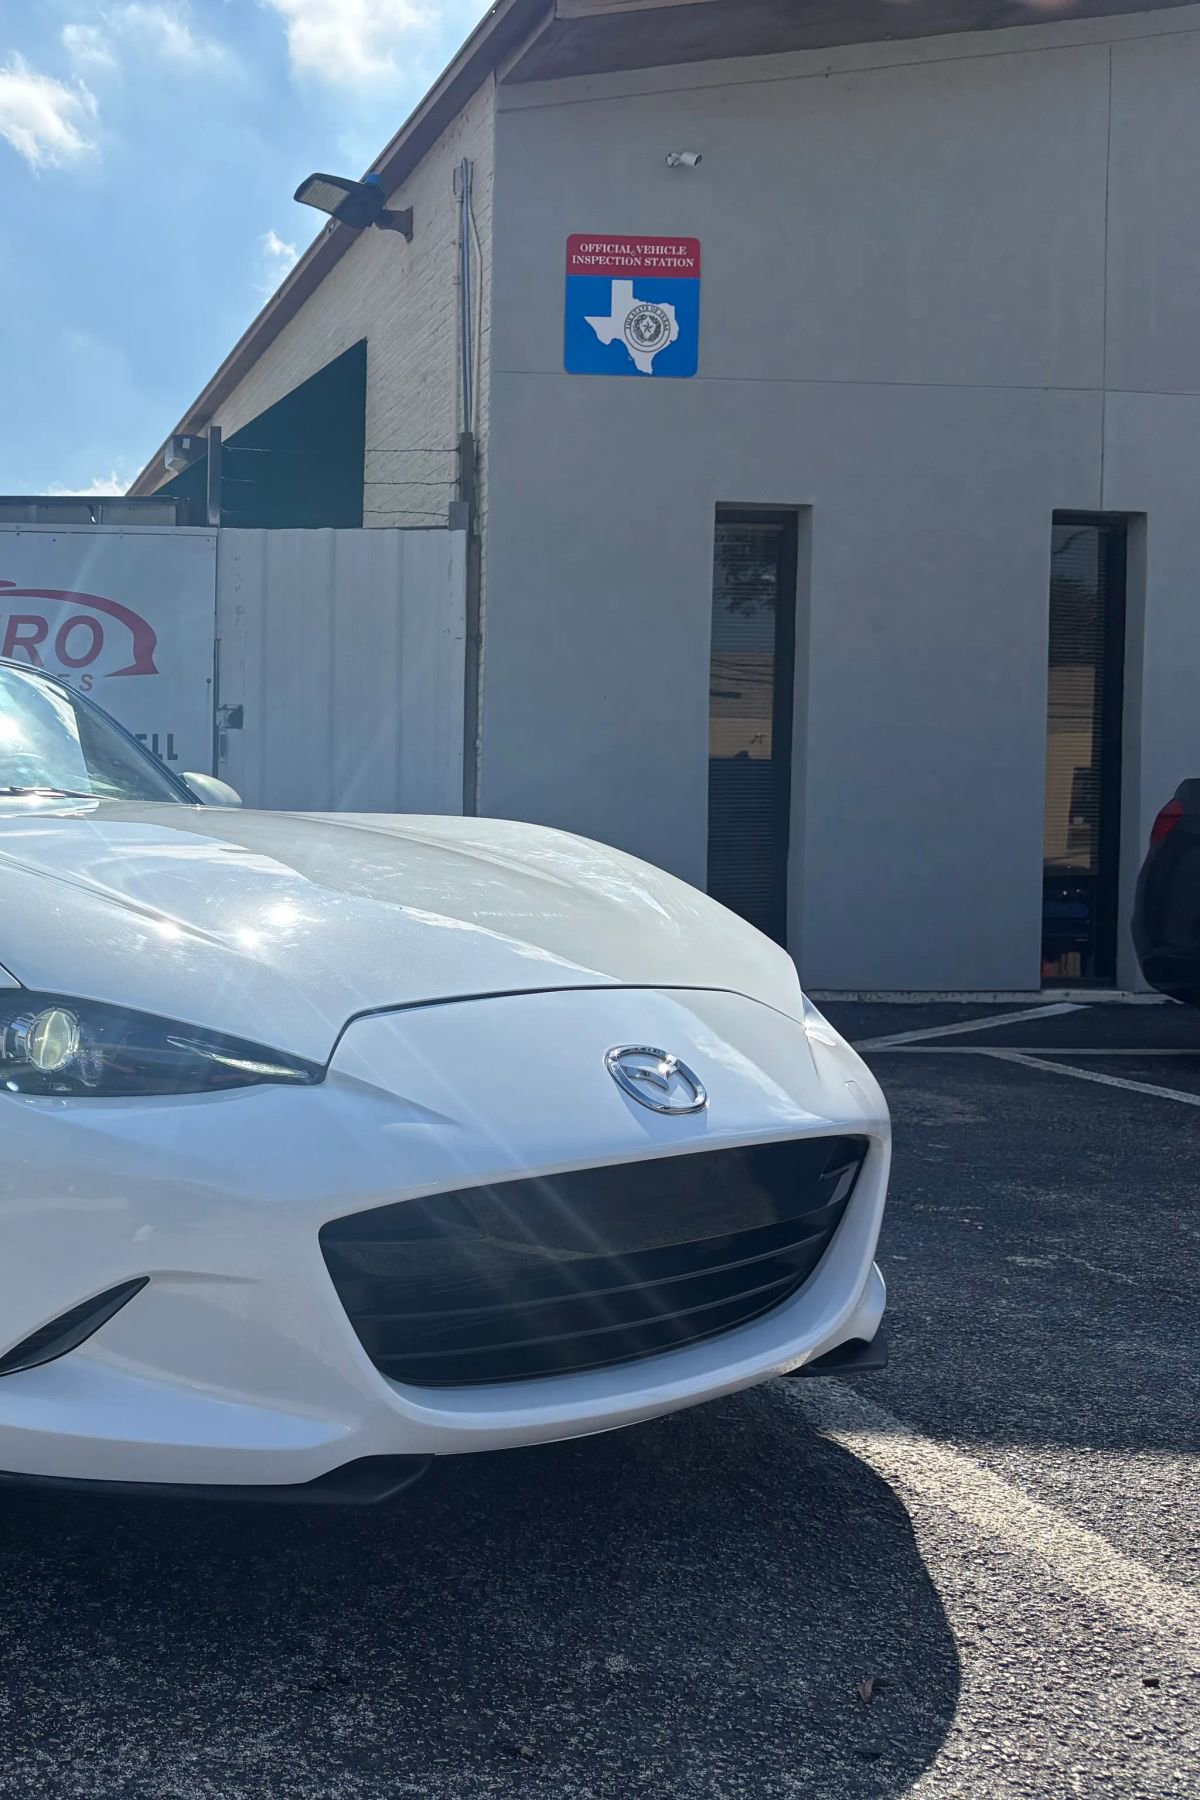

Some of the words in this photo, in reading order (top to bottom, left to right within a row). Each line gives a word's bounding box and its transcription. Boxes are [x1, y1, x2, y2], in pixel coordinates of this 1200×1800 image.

[580, 244, 632, 254] OFFICIAL
[637, 246, 687, 255] VEHICLE
[572, 256, 641, 266] INSPECTION
[644, 258, 694, 267] STATION
